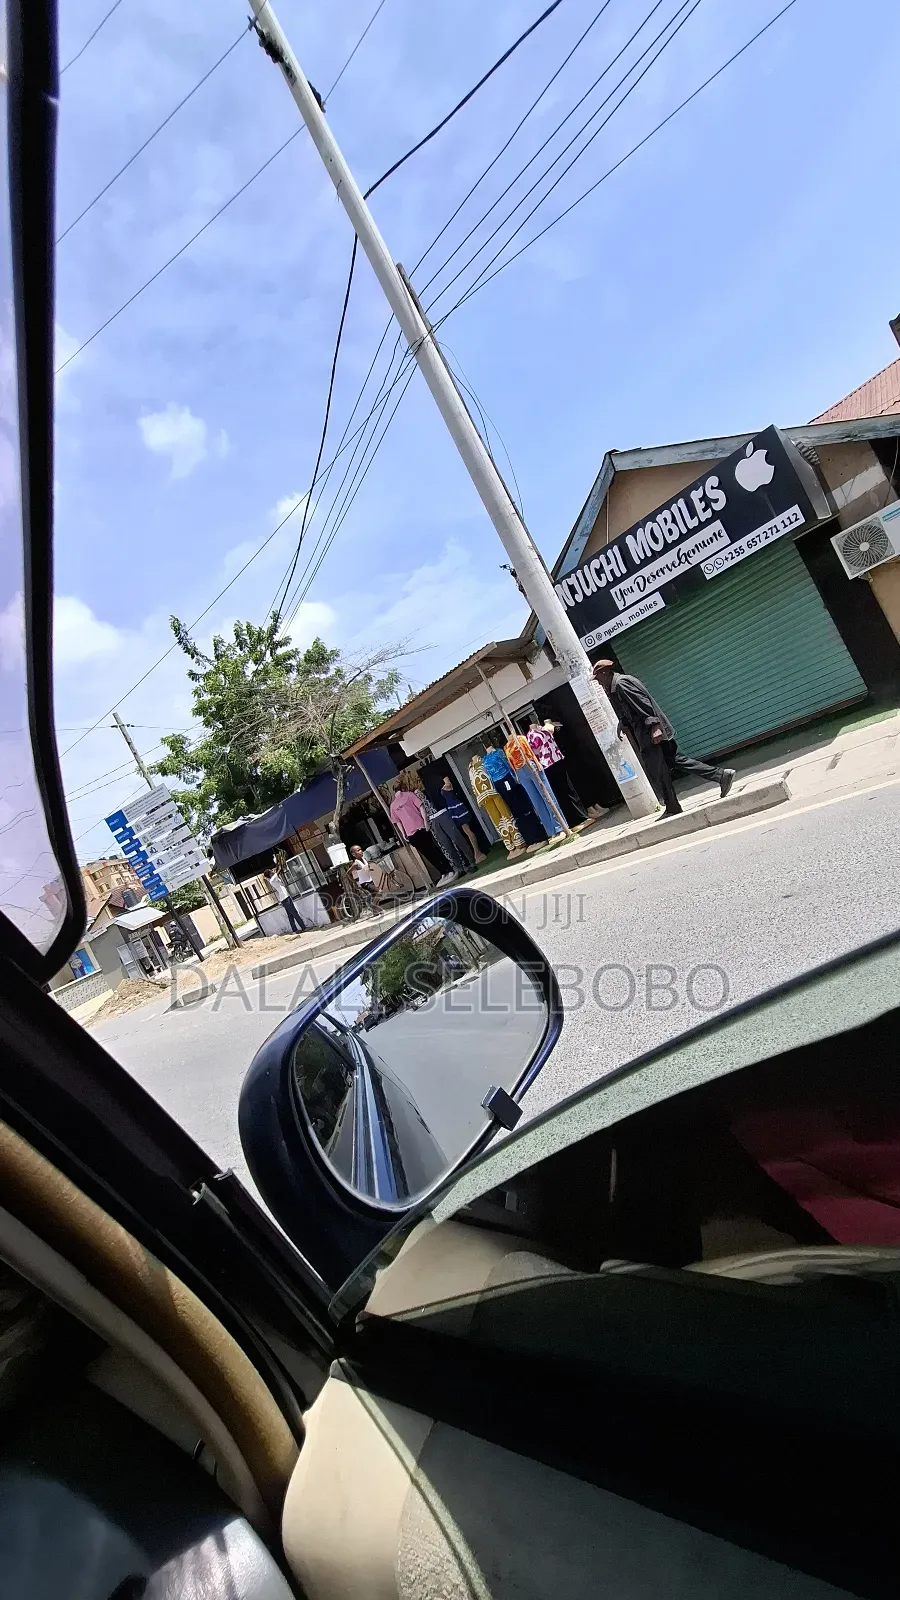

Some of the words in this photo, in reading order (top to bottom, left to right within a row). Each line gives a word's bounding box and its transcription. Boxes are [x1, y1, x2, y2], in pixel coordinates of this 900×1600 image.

[554, 545, 627, 611] NJUCHI
[626, 475, 727, 565] MOBILES
[724, 545, 746, 563] +255
[746, 534, 763, 550] 657
[762, 525, 780, 540] 271
[780, 512, 800, 529] 112
[614, 585, 635, 607] You
